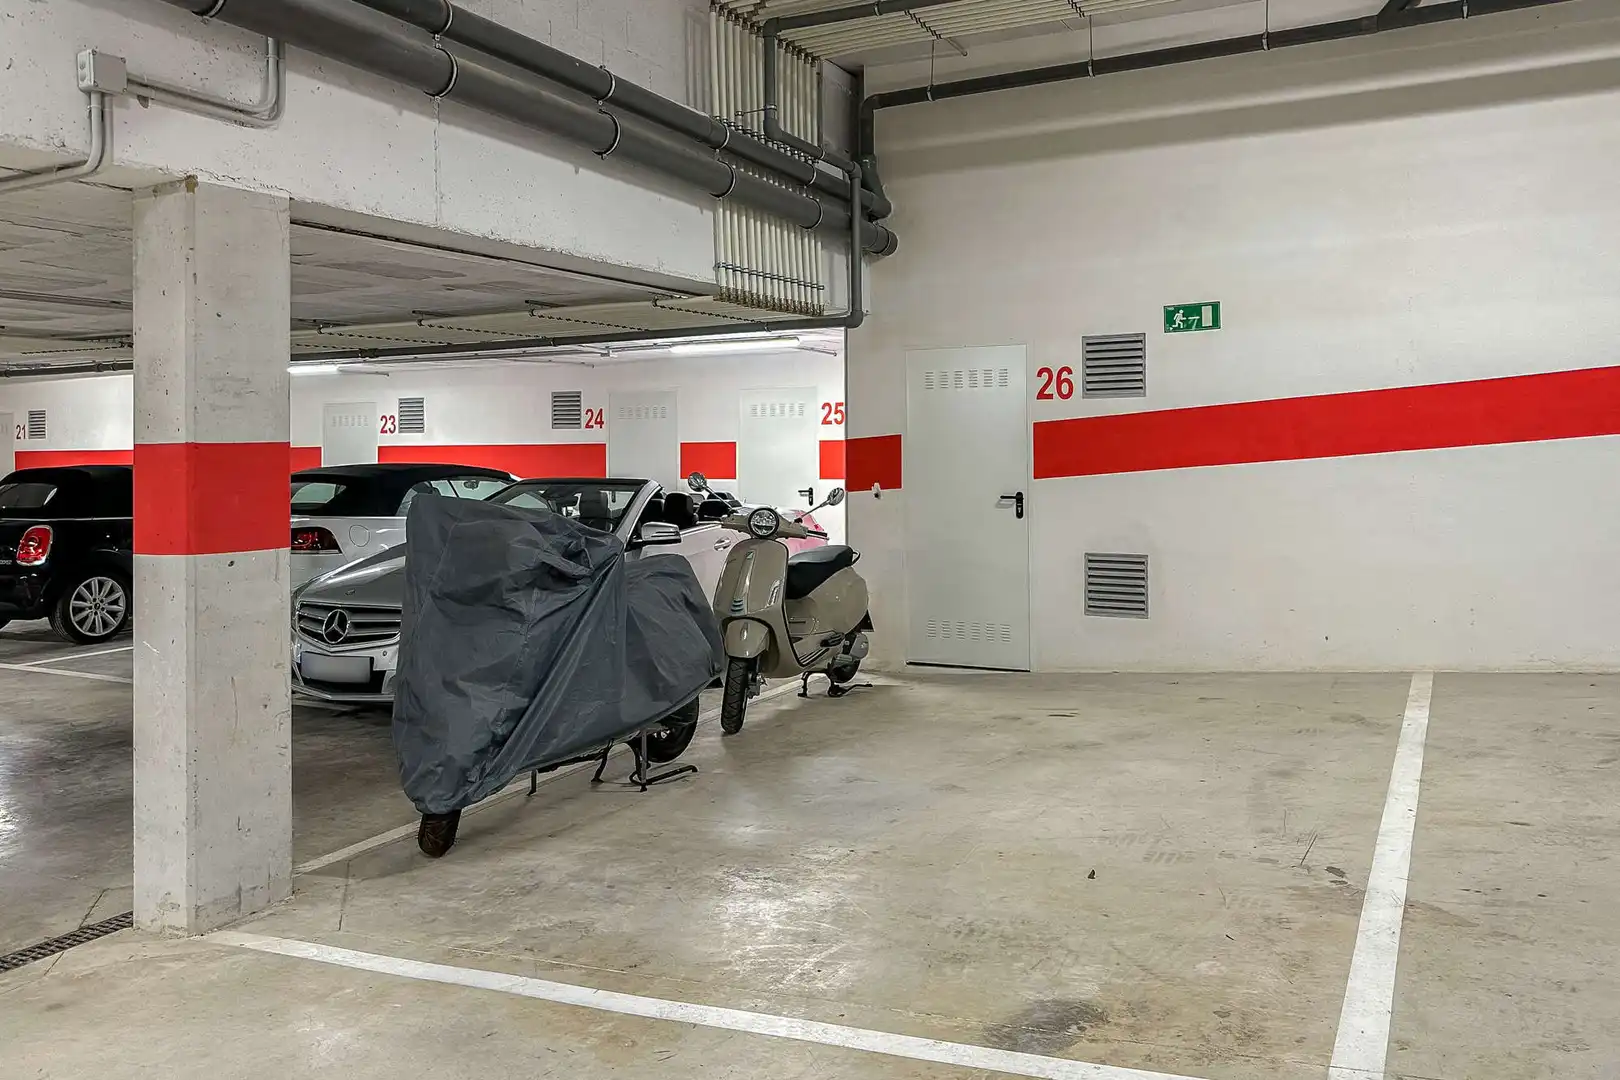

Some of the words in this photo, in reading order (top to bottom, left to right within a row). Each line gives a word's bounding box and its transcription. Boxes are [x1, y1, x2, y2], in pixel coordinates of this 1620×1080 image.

[1036, 366, 1074, 400] 26
[584, 408, 605, 429] 24
[821, 402, 846, 425] 25
[16, 424, 26, 440] 21
[380, 415, 396, 434] 23
